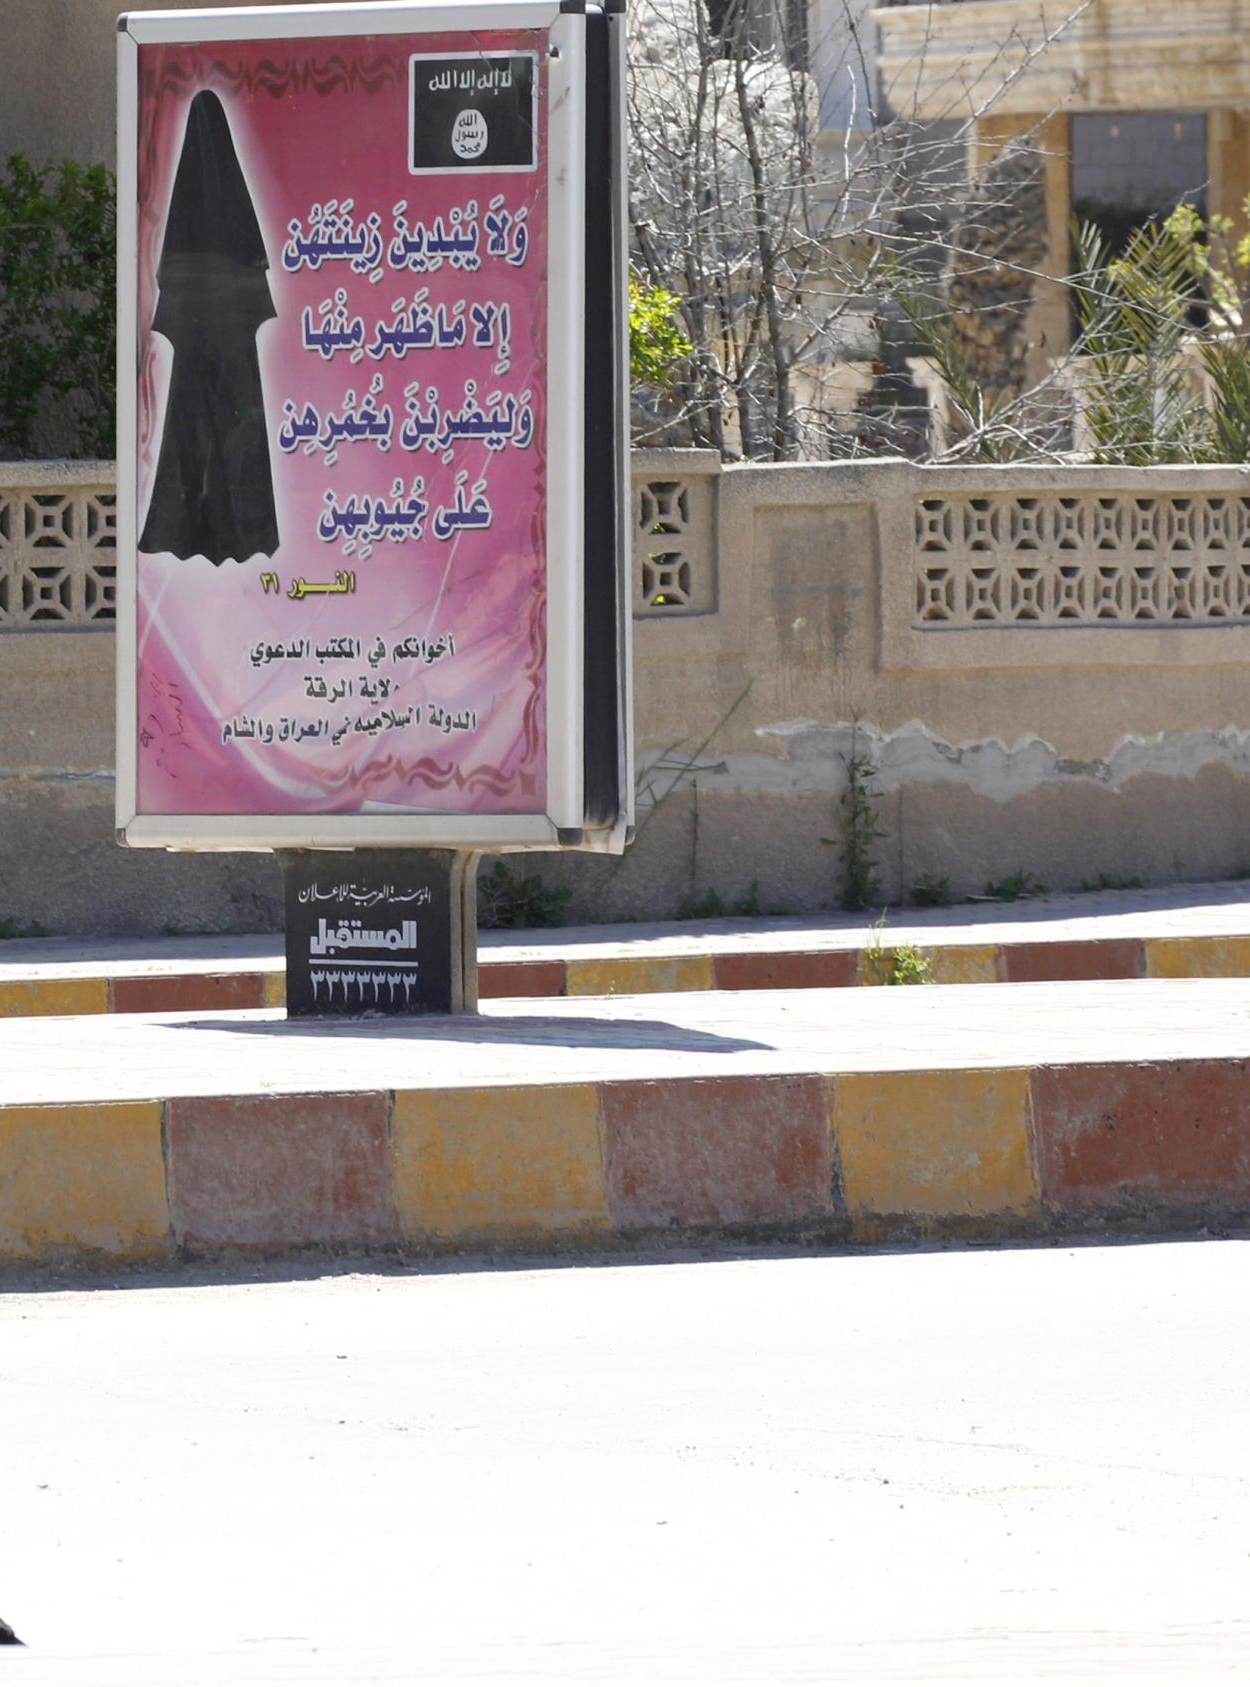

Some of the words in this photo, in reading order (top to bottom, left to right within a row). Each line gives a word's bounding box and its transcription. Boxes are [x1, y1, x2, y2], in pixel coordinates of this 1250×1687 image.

[315, 637, 360, 664] المكتب
[368, 636, 386, 669] في
[305, 676, 352, 703] الرقة
[223, 716, 274, 743] والشام
[279, 718, 329, 742] العراق
[428, 704, 477, 733] الدولة
[310, 918, 417, 955] المستقبل
[310, 970, 417, 1003] ٣٣٣٣٣٣٣
